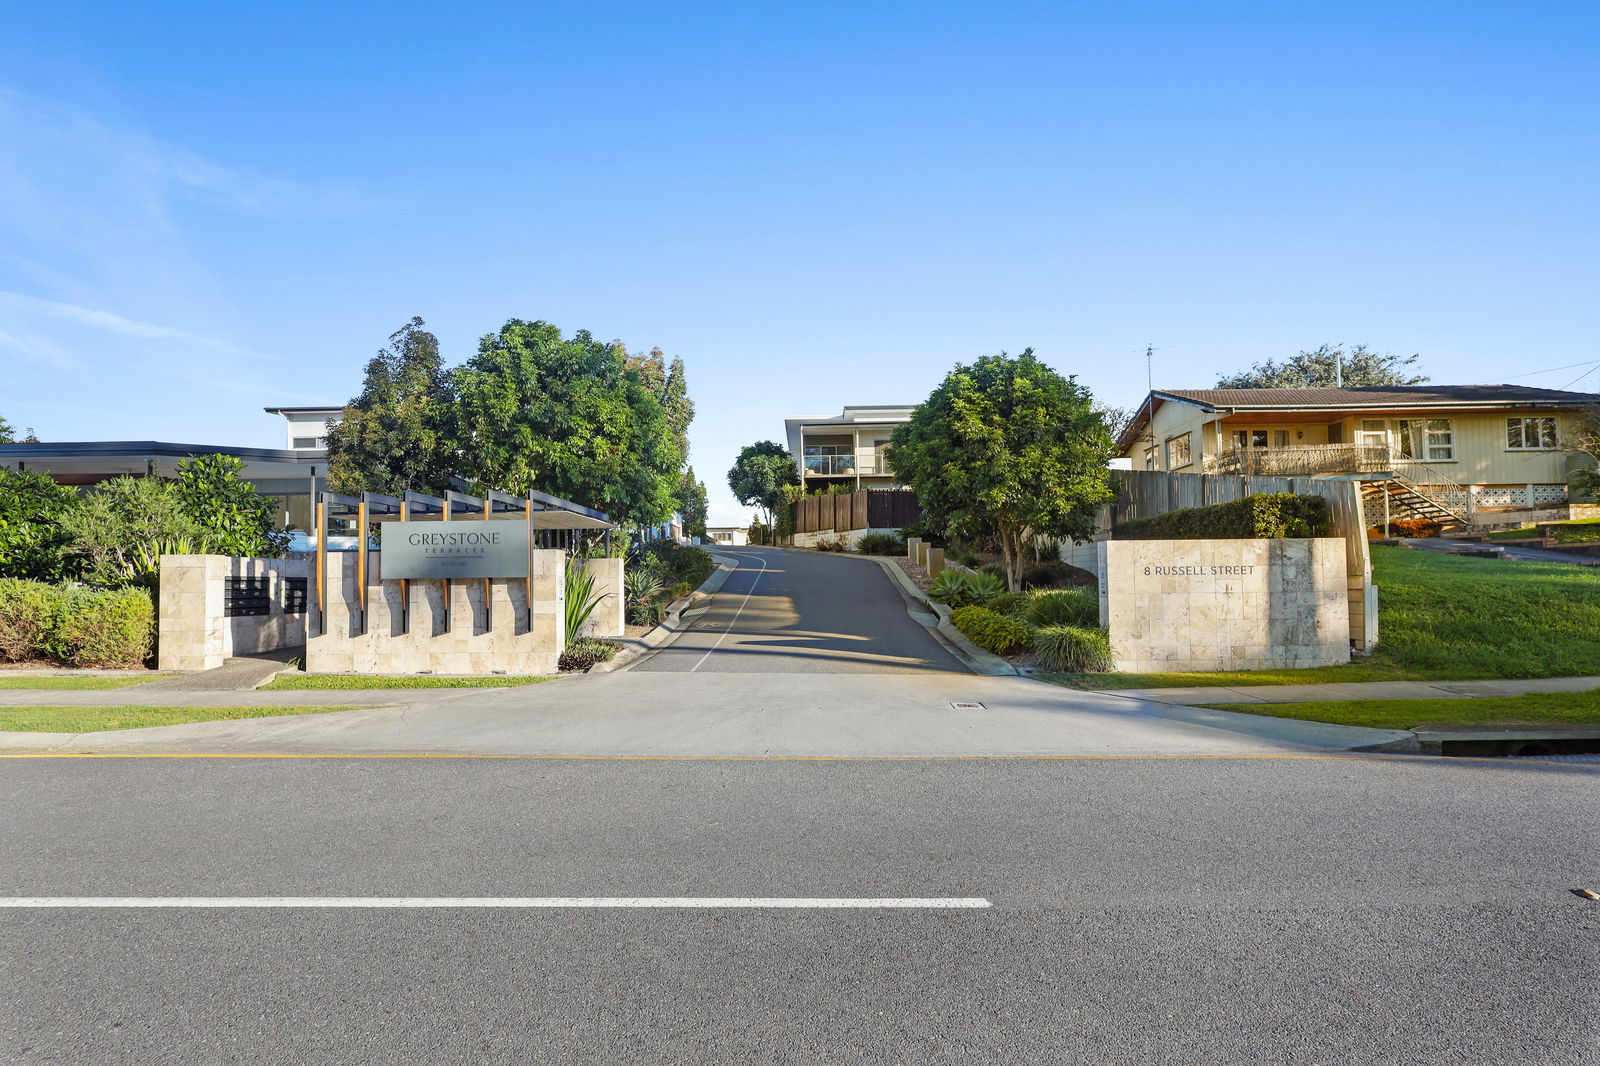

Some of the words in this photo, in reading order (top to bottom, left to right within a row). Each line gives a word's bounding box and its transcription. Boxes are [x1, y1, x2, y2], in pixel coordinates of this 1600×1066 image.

[408, 532, 501, 546] GREYSTONE
[1144, 566, 1151, 576] 8
[1155, 566, 1206, 576] RUSSELL
[1210, 565, 1255, 575] STREET
